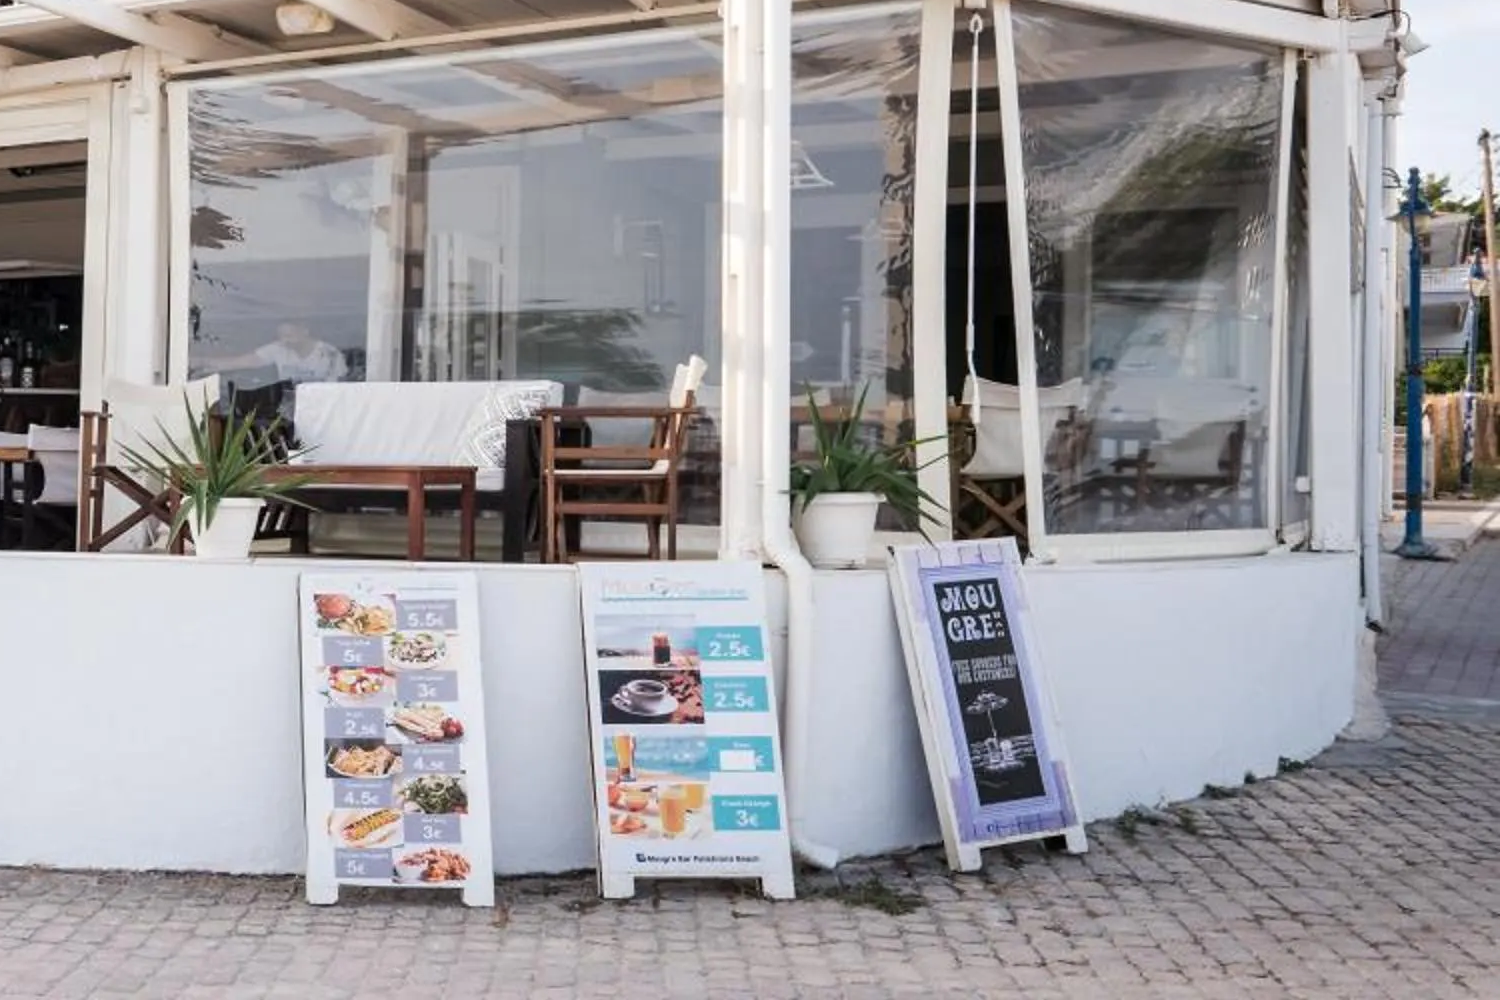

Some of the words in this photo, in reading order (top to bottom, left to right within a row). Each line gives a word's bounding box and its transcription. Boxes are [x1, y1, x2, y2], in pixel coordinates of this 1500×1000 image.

[940, 583, 997, 613] MOU
[708, 642, 751, 658] 2.5€
[713, 692, 755, 709] 2.5€
[735, 809, 759, 828] 3€
[423, 825, 442, 840] 3€
